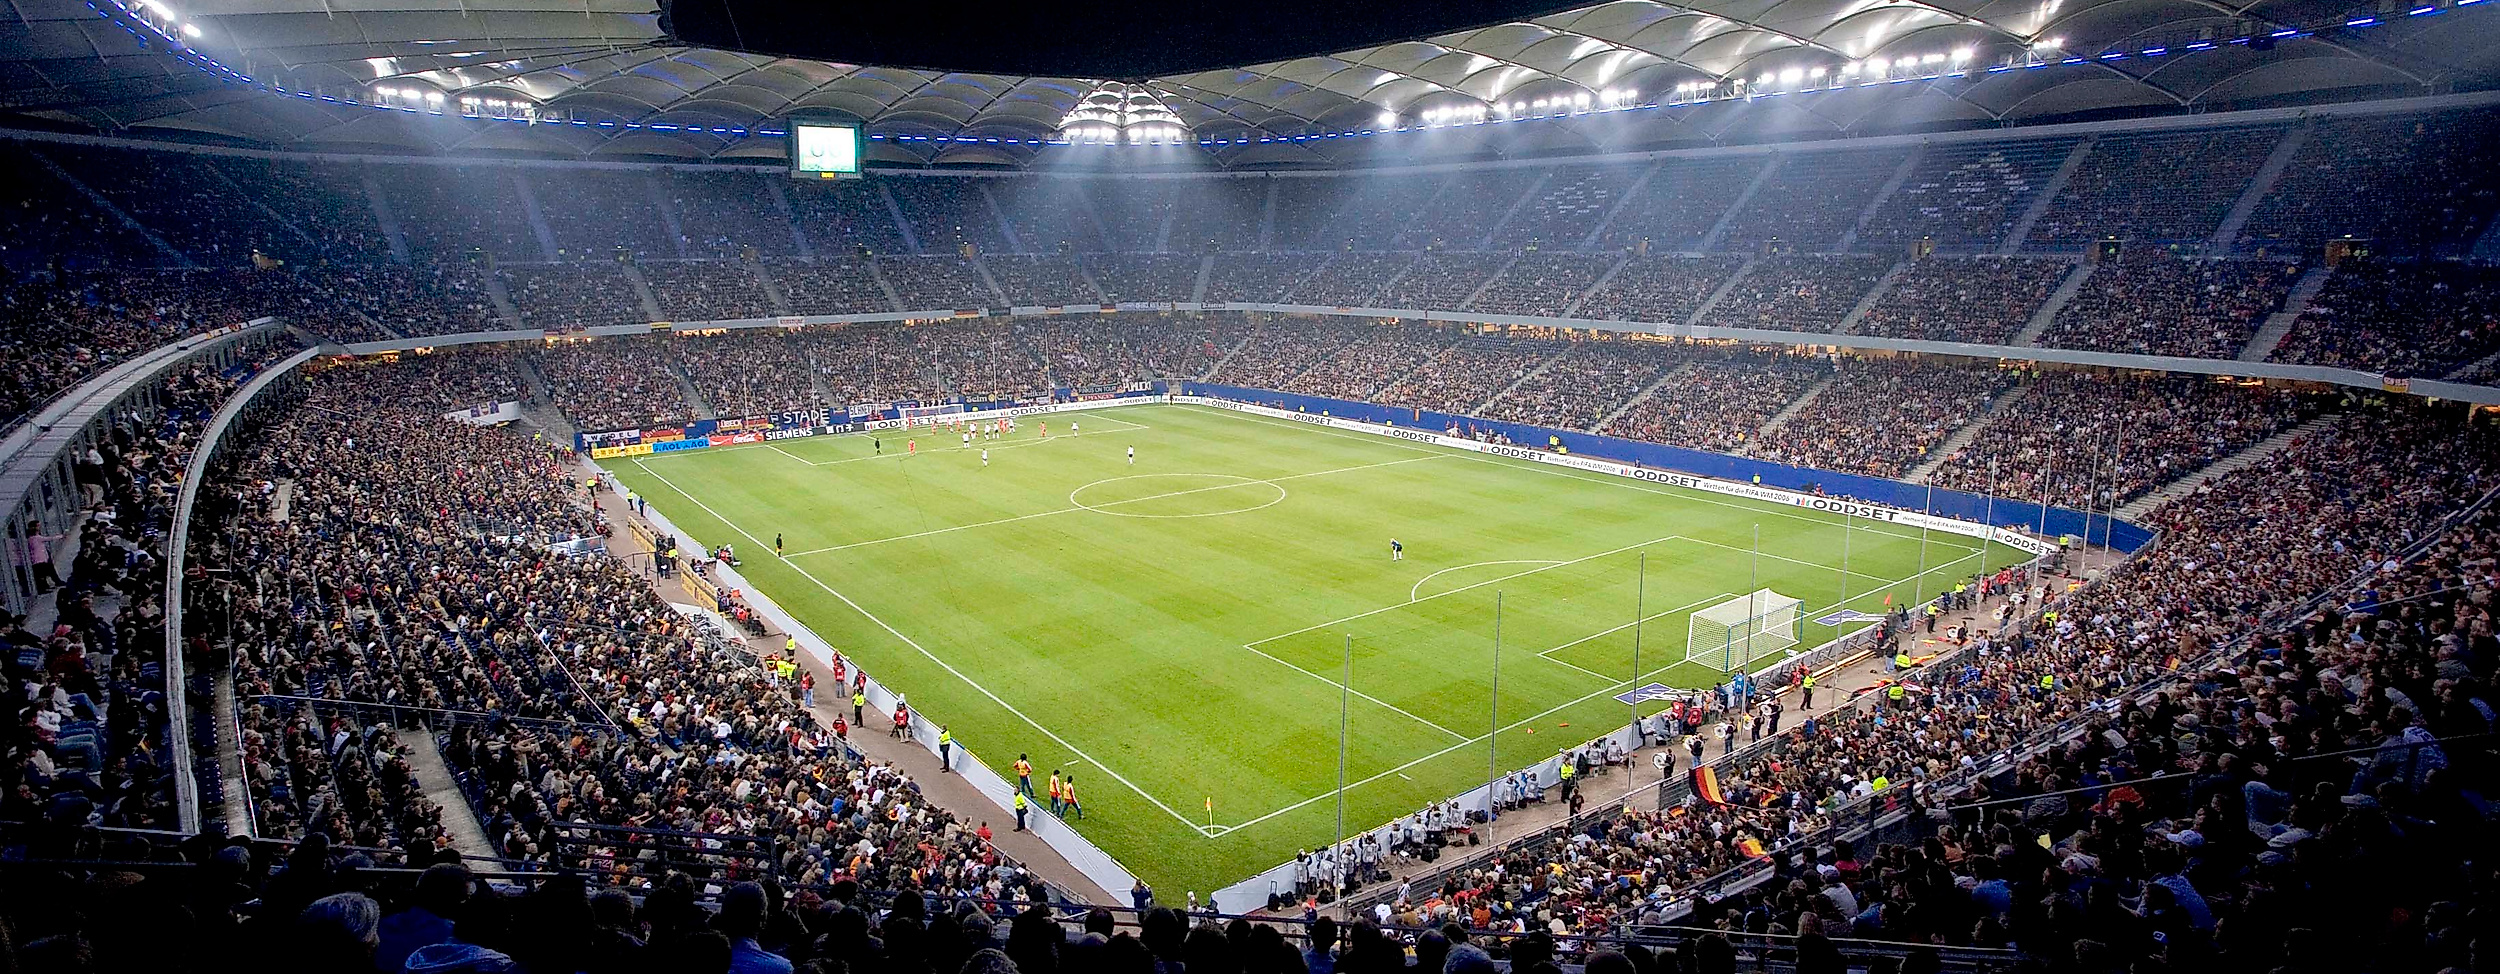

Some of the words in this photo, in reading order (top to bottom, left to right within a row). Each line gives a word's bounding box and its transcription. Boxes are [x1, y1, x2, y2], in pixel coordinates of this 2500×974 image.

[1011, 405, 1059, 416] ODDSET
[1212, 400, 1243, 411] ODDSET
[782, 408, 831, 424] STADE
[1294, 414, 1332, 426] ODDSET
[766, 428, 813, 441] SIEMENS
[1392, 429, 1439, 444] ODDSET
[662, 442, 680, 451] AOL
[690, 439, 710, 448] AOL
[1490, 446, 1545, 461] ODDSET
[1633, 469, 1702, 488] ODDSET
[1703, 482, 1725, 491] Wetten
[1744, 487, 1759, 497] FIFA
[1760, 490, 1773, 499] WM
[1812, 499, 1900, 521] ODDSET
[2004, 535, 2053, 555] ODDSET
